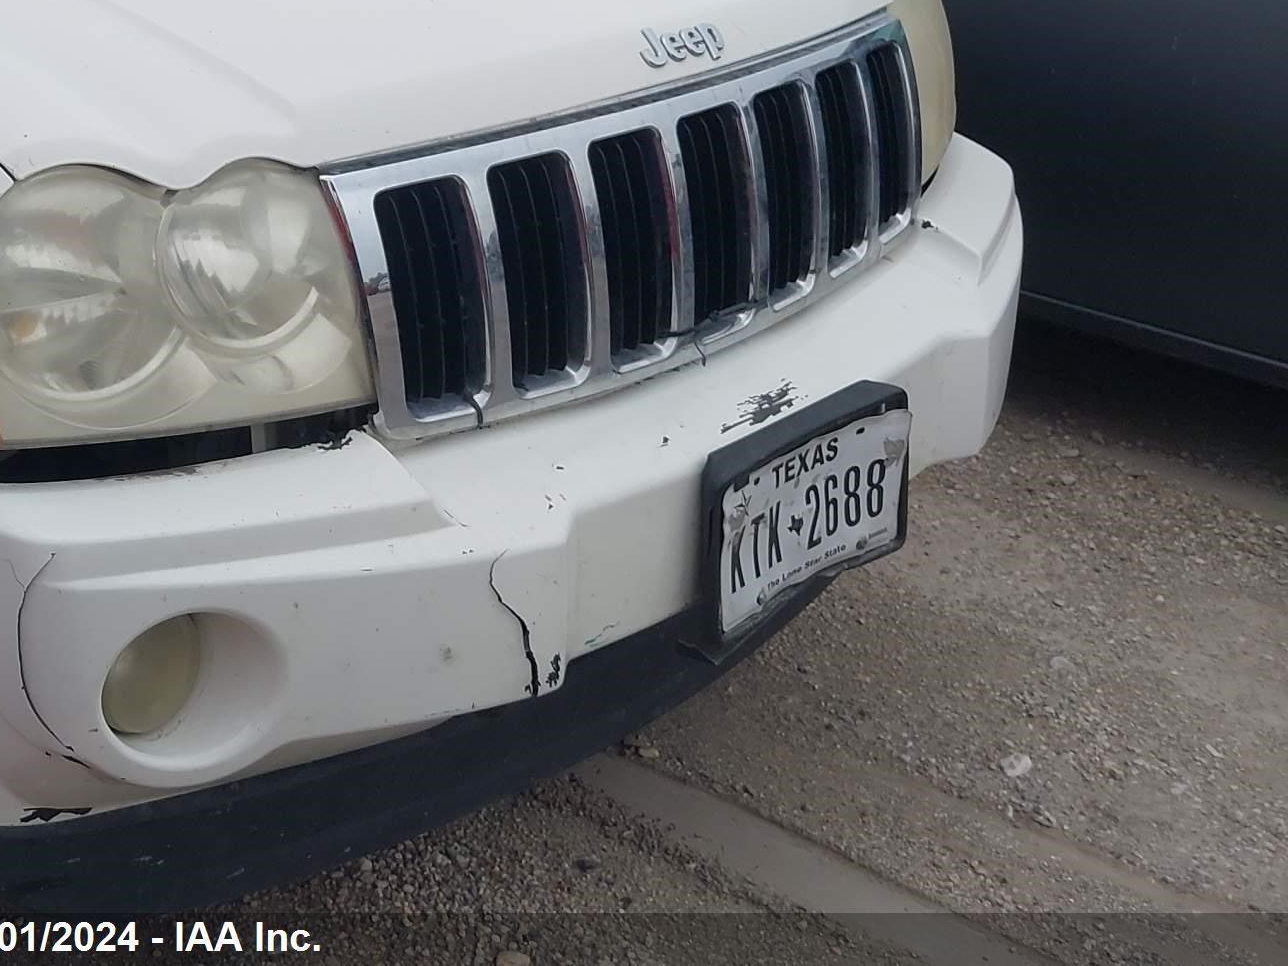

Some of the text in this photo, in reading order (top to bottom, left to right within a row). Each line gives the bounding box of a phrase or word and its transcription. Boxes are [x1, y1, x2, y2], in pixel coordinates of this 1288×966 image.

[640, 22, 725, 68] Jeep
[772, 437, 840, 489] TEXAS
[730, 458, 888, 594] KTK 2688
